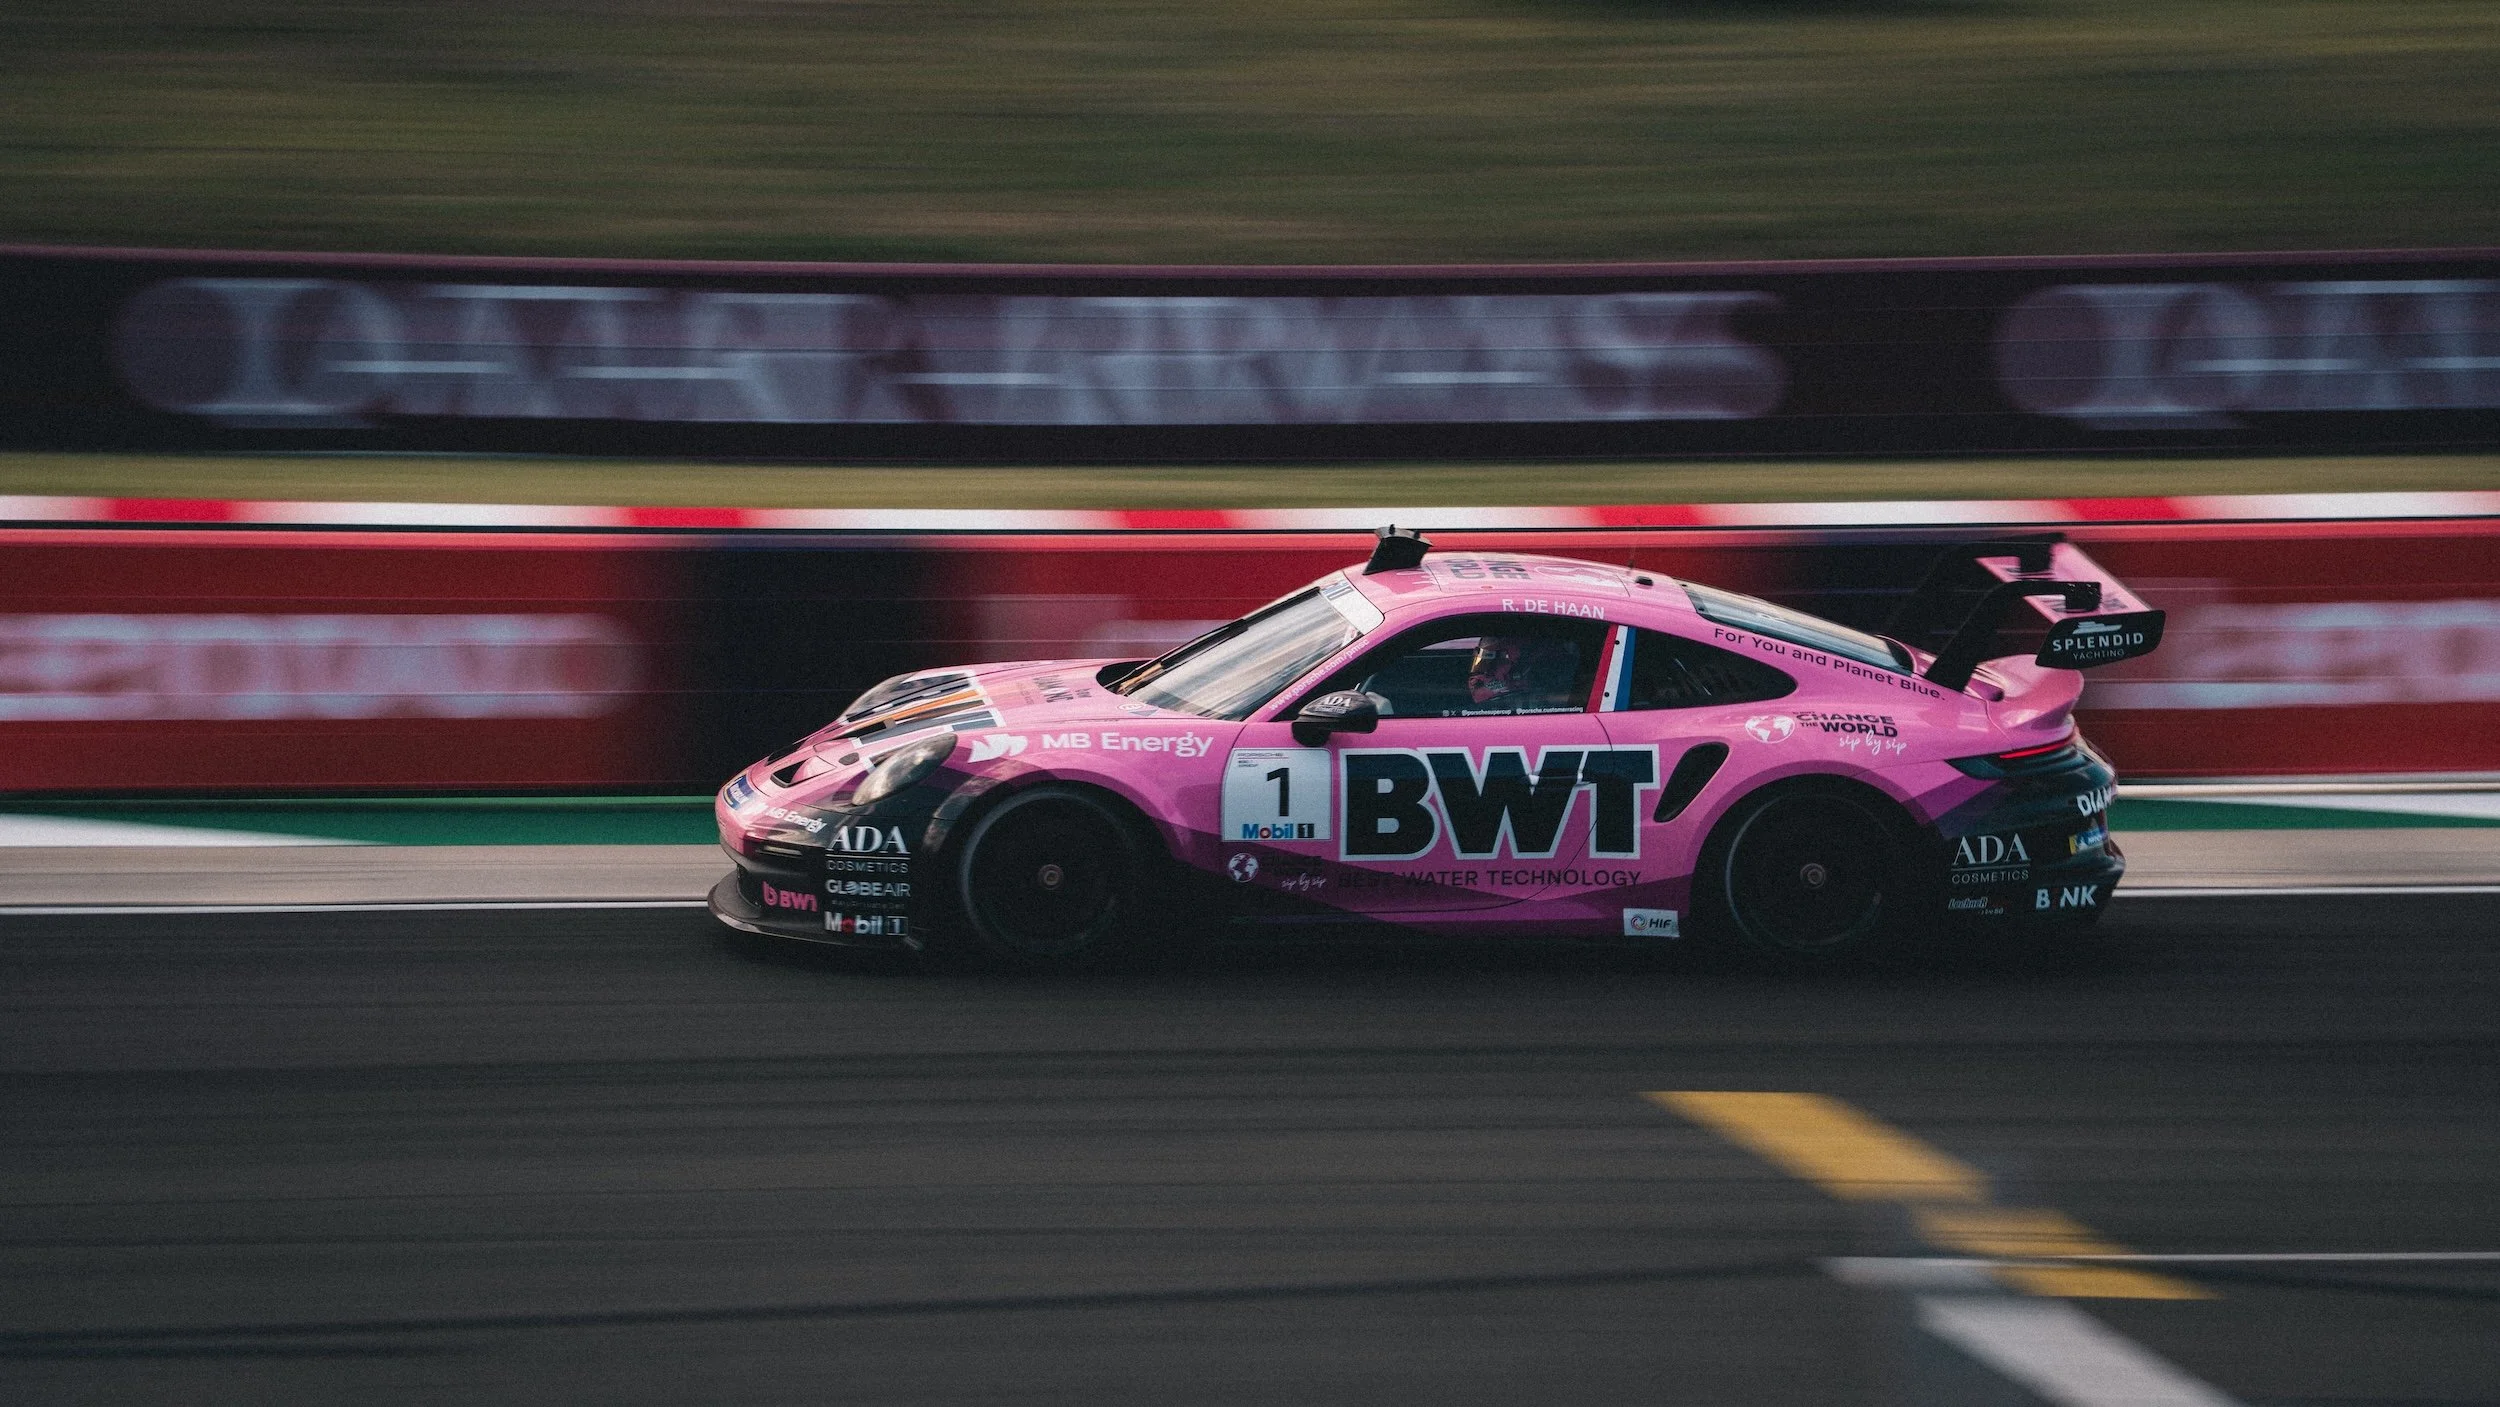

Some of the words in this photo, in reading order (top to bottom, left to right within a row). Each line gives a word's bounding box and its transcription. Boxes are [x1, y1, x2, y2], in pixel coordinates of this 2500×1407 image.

[1502, 598, 1519, 612] R.
[1524, 599, 1548, 613] DE
[1554, 601, 1604, 619] HAAN
[2052, 632, 2144, 652] SPLENDID
[1714, 627, 1744, 645] For
[1752, 636, 1785, 655] You
[1792, 647, 1826, 666] and
[1833, 659, 1893, 686] Planet
[1900, 679, 1946, 700] Blue.
[2072, 649, 2125, 661] YACHTING
[1796, 713, 1896, 726] CHANGE
[1820, 721, 1898, 738] WORLD
[1042, 732, 1091, 749] MB
[1101, 731, 1214, 757] Energy
[1839, 735, 1861, 752] sip
[1865, 729, 1882, 755] by
[1885, 738, 1908, 755] sip
[1266, 767, 1289, 817] 1
[1340, 744, 1660, 861] BWT
[784, 810, 827, 834] Energy
[1242, 823, 1294, 839] Mobil
[825, 825, 911, 854] ADA
[1951, 833, 2031, 866] ADA
[826, 859, 910, 873] COSMETICS
[1401, 870, 1478, 887] WATER
[1486, 869, 1641, 887] TECHNOLOGY
[1951, 869, 2030, 885] COSMETICS
[825, 911, 883, 935] Mobil
[1650, 918, 1672, 929] HIF
